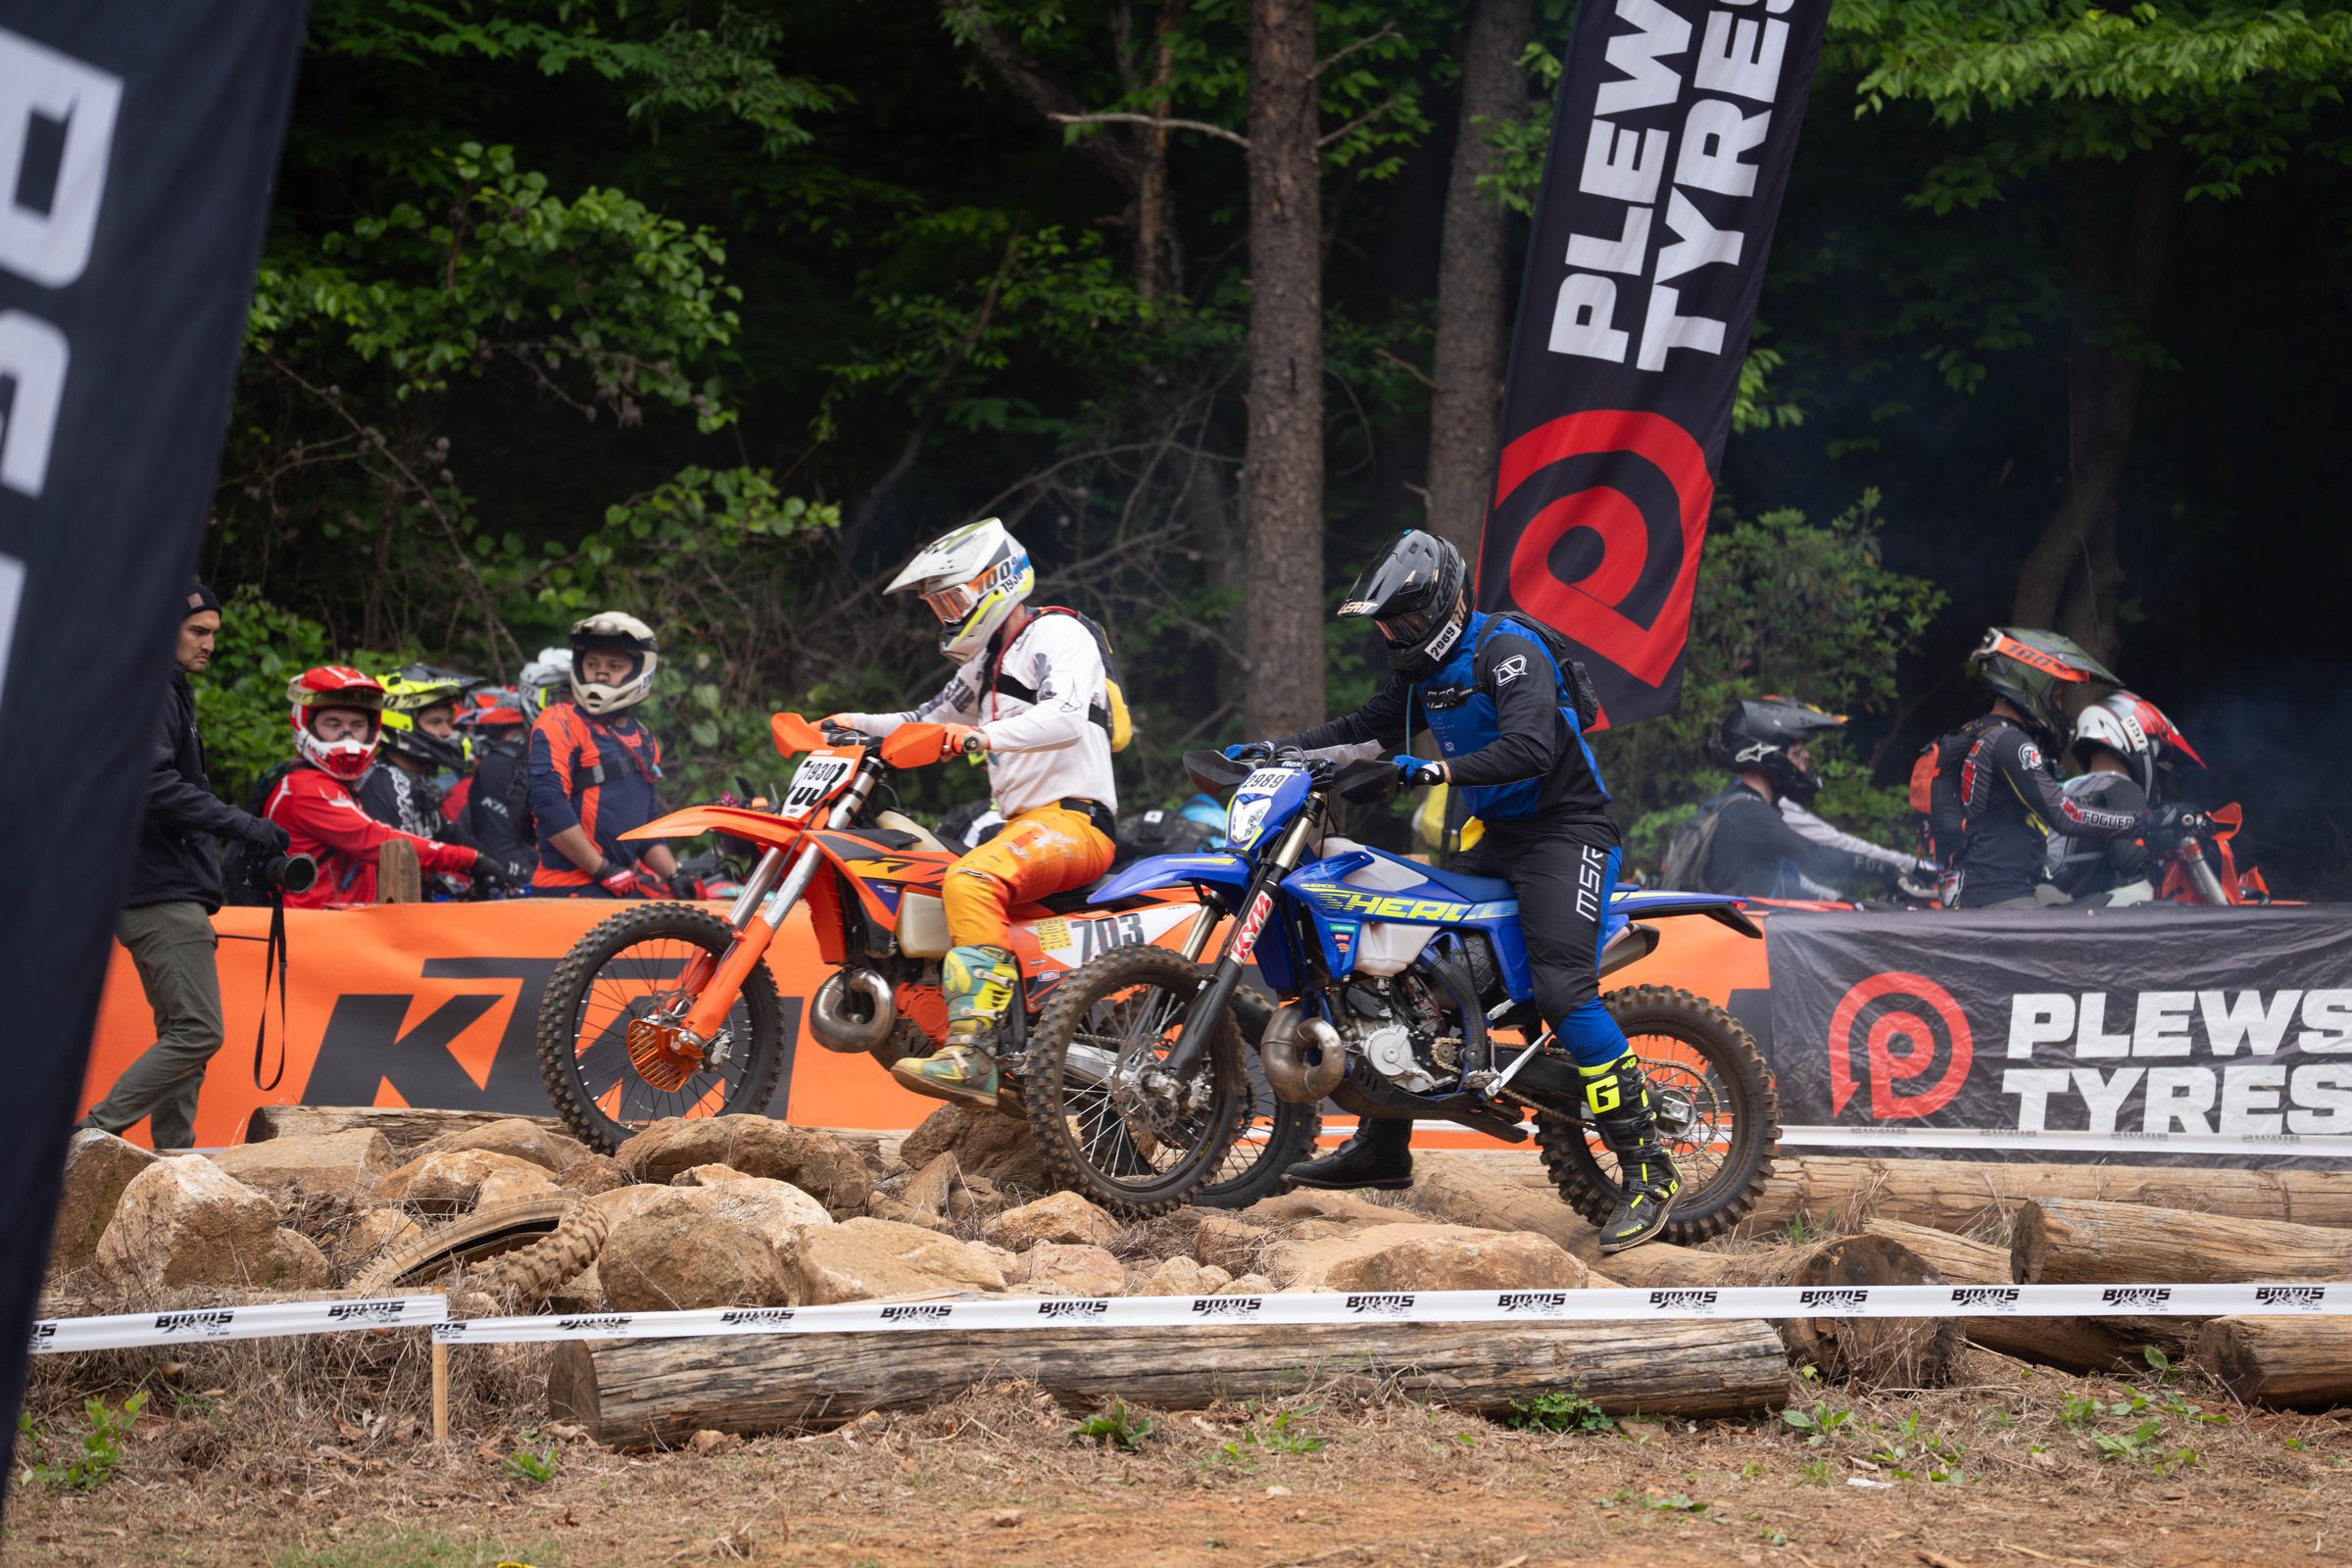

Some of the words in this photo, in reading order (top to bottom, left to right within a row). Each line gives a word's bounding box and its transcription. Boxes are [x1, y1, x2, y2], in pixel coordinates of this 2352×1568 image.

[1637, 0, 1794, 371] TYRE
[1242, 774, 1286, 789] 2989
[1576, 845, 1603, 922] MSR
[1070, 912, 1146, 965] 703
[1231, 894, 1271, 959] KYB
[2007, 989, 2352, 1058] PLEWS
[2002, 1064, 2352, 1135] TYRES
